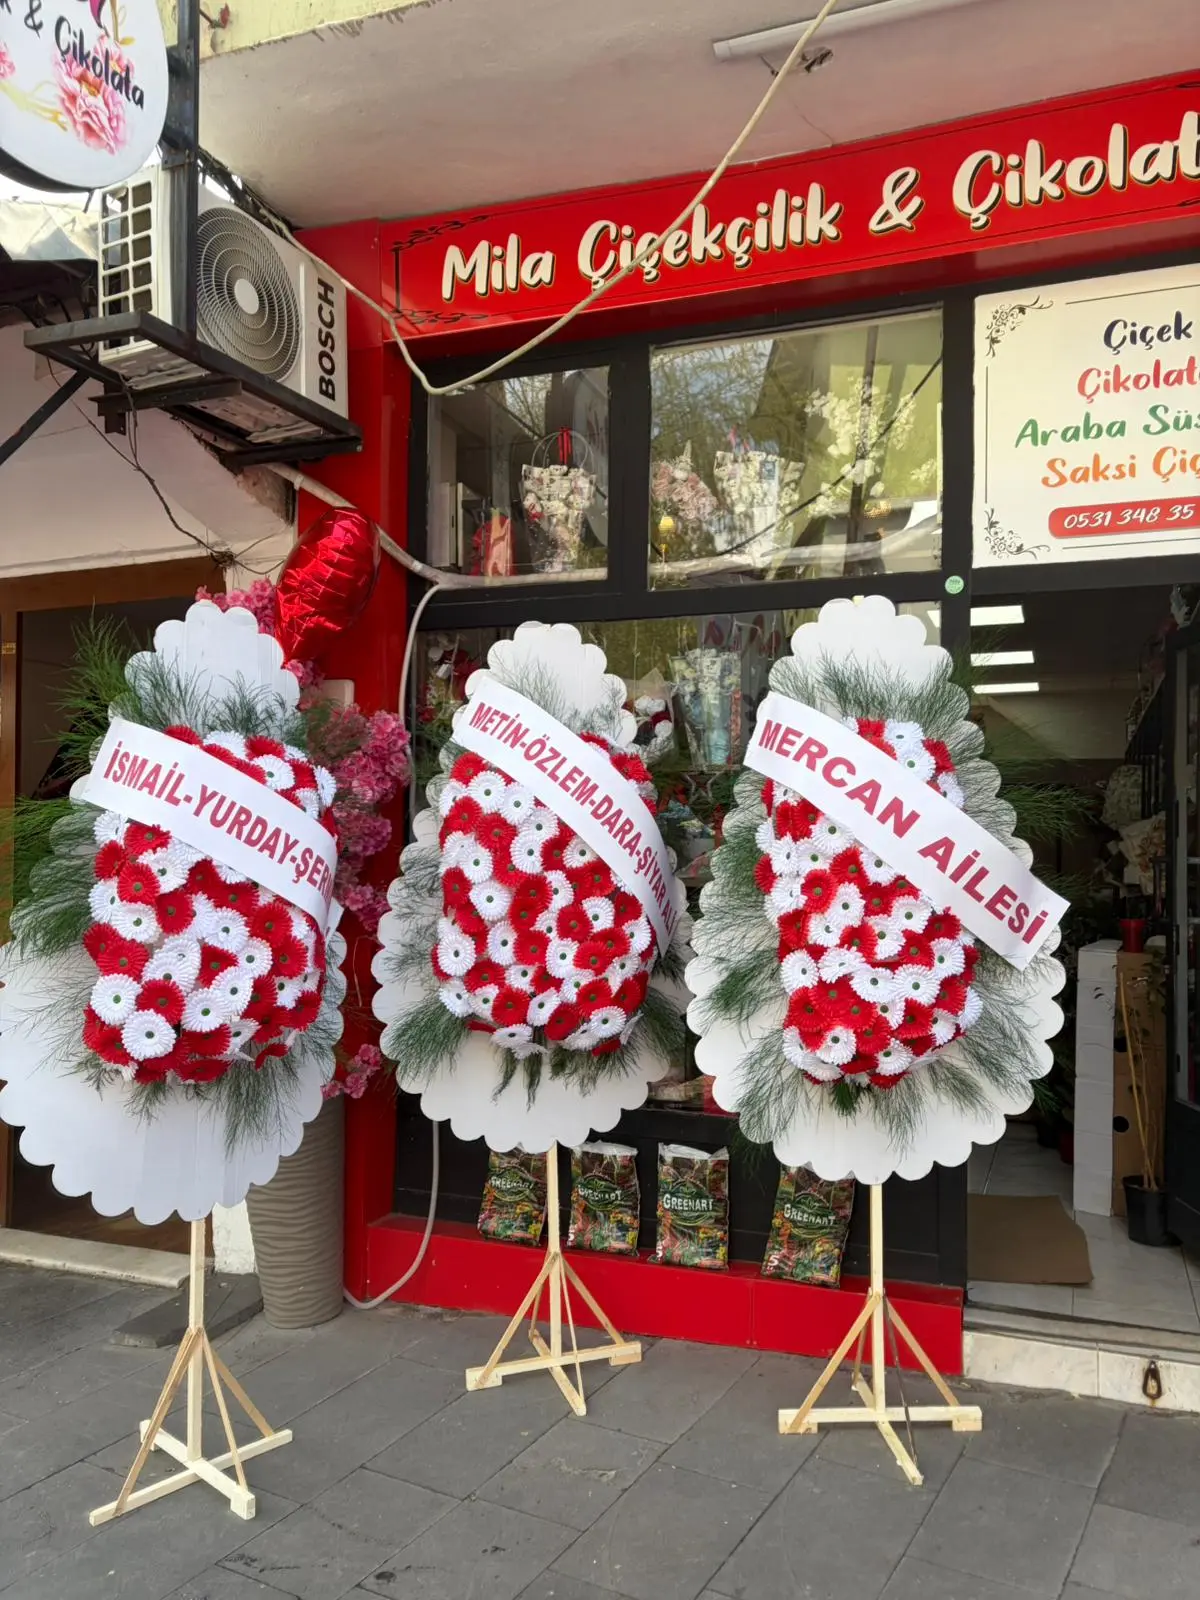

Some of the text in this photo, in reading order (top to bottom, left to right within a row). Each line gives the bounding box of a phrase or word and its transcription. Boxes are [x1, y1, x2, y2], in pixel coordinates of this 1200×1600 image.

[55, 15, 144, 110] Çikolata
[441, 232, 555, 302] Mila
[577, 182, 844, 292] Çiçekçilik
[868, 166, 924, 234] &
[317, 276, 336, 402] BOSCH
[1103, 310, 1194, 355] Çiçek
[1077, 356, 1200, 404] Çikolat
[1015, 411, 1126, 448] Araba
[1041, 453, 1137, 488] Saksi
[1063, 503, 1196, 530] 0531 348 35
[758, 719, 1049, 945] MERCAN AİLESİ
[662, 1192, 714, 1211] GREENART
[783, 1203, 836, 1226] GREENART
[767, 1253, 780, 1267] 5
